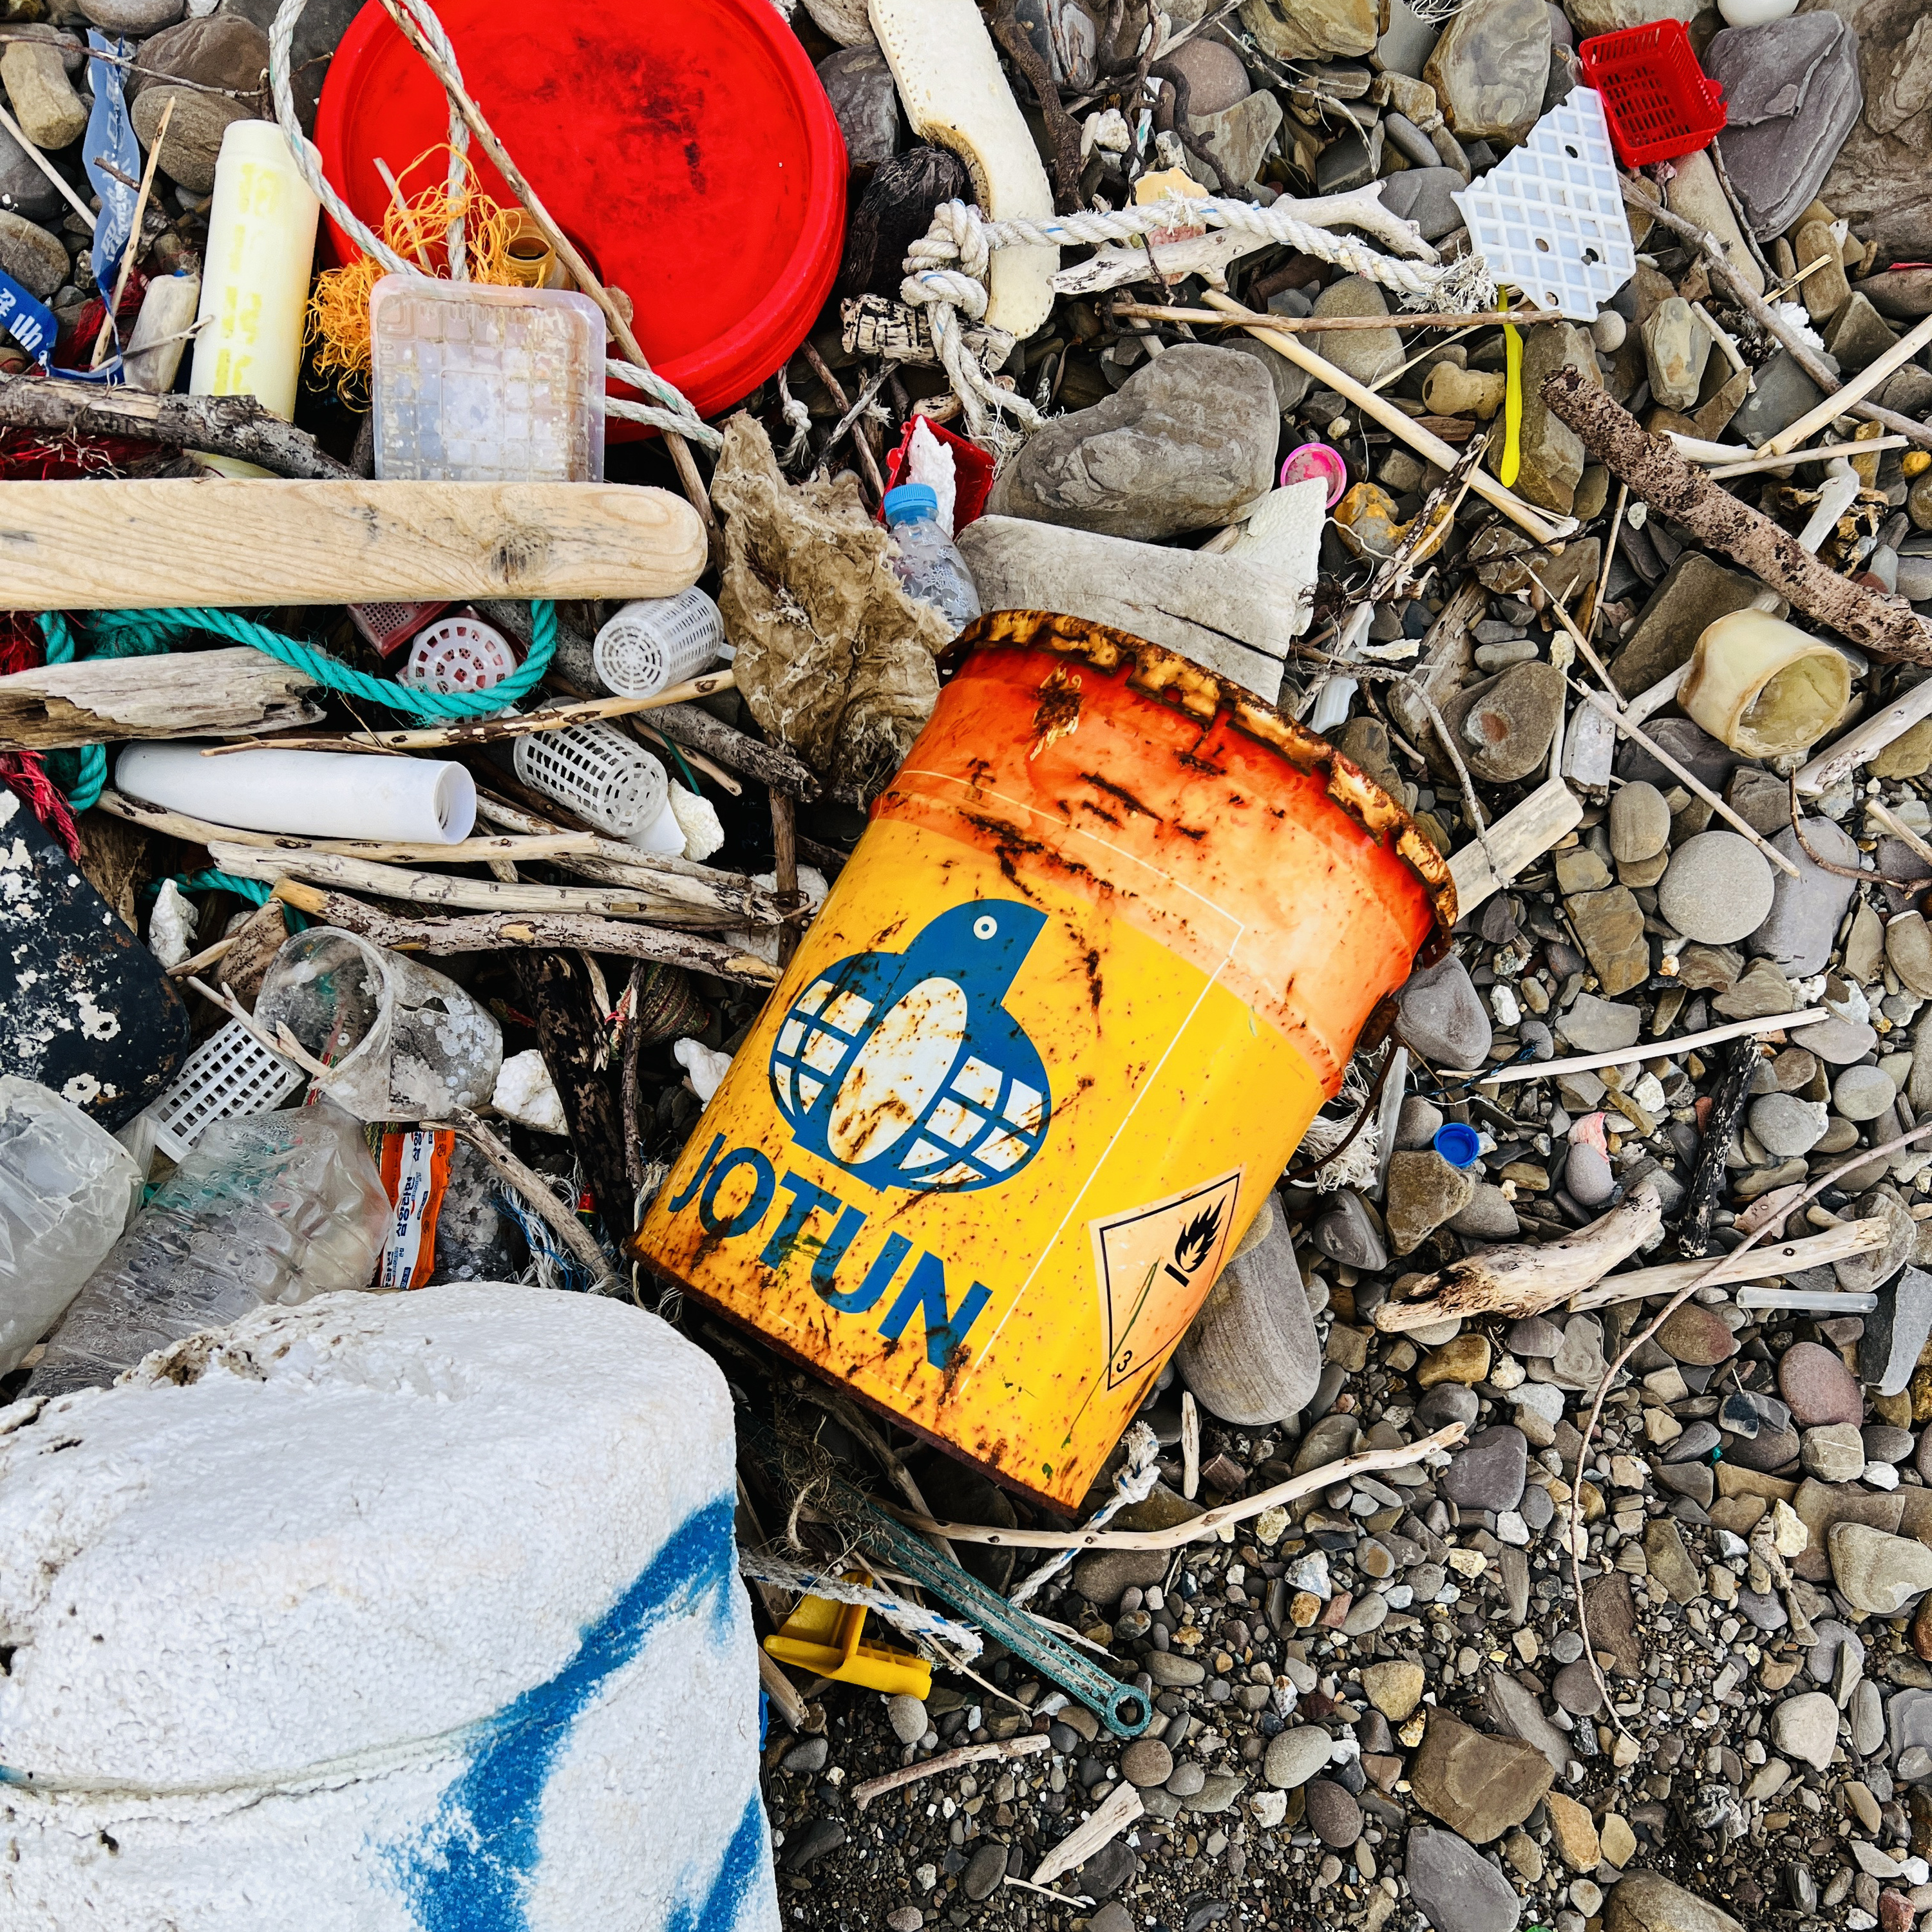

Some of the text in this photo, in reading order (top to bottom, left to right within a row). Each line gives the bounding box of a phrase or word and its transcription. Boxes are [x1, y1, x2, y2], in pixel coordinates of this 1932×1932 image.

[395, 1177, 415, 1237] 삼양라면
[668, 1132, 994, 1372] JOTUN
[1116, 1350, 1133, 1373] 3
